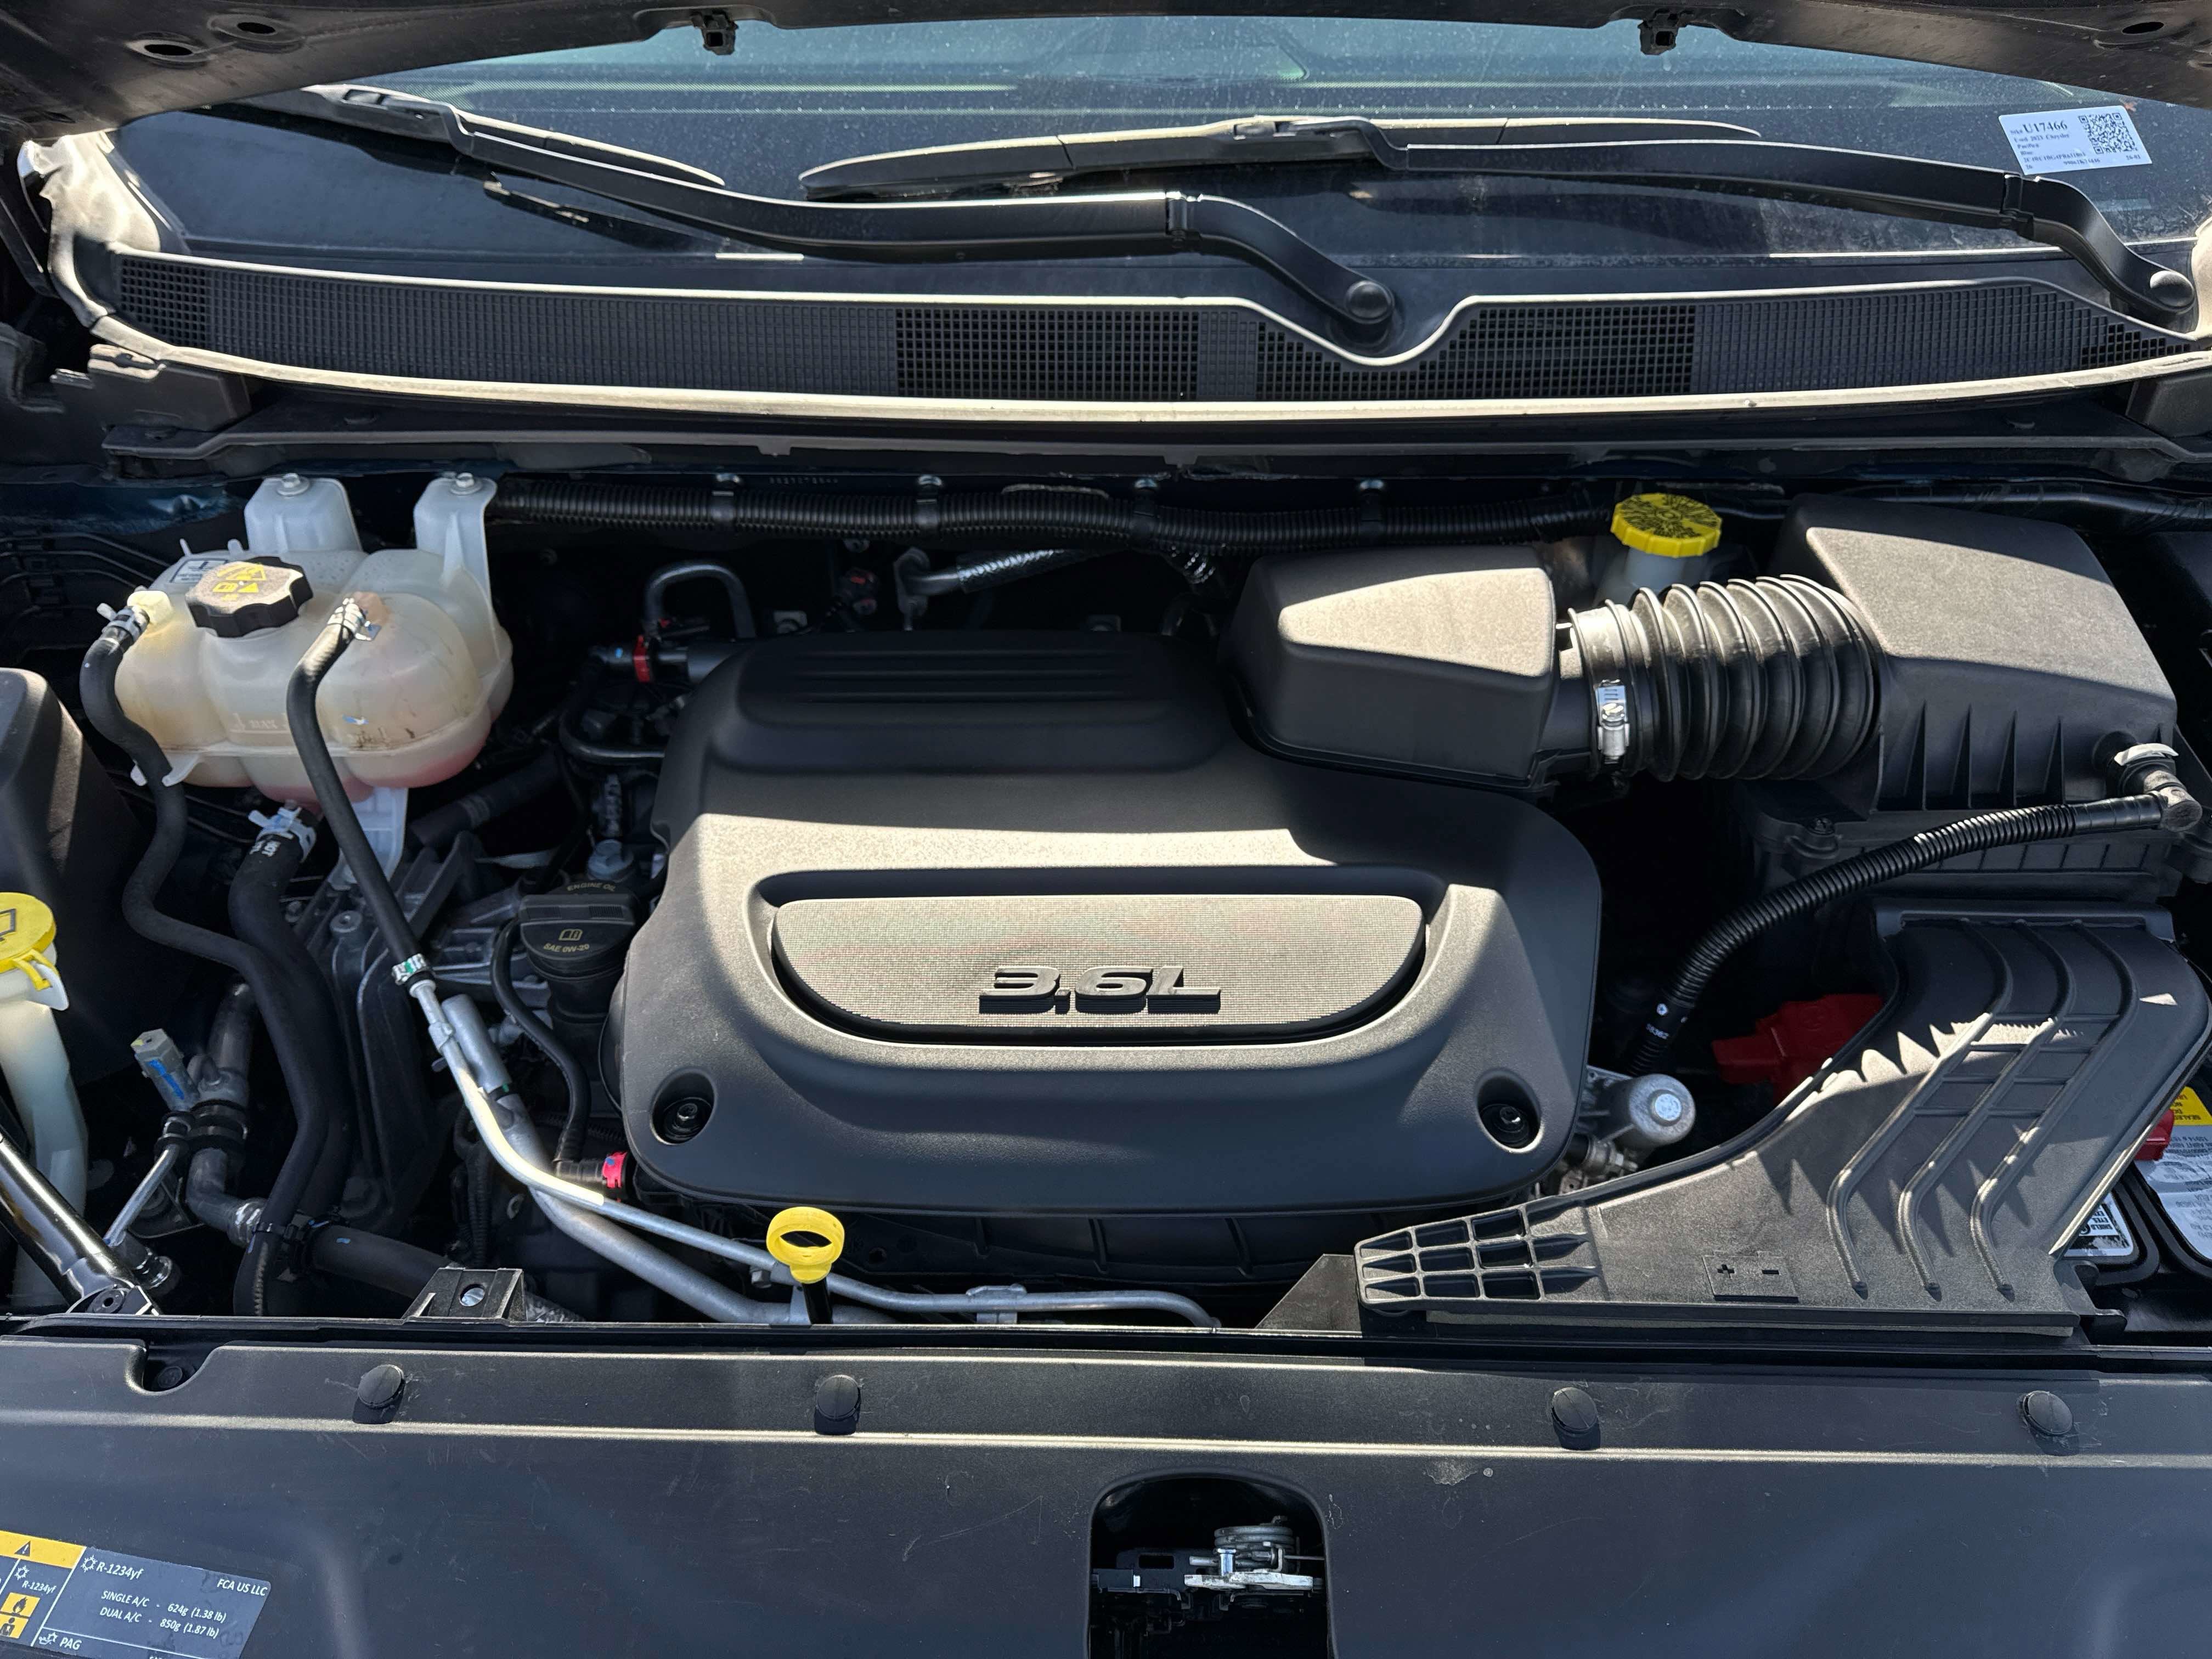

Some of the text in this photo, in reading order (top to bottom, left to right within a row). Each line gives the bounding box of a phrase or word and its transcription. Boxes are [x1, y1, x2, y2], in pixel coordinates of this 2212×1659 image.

[2023, 120, 2068, 133] U17466
[566, 882, 616, 891] ENGINE OIL
[544, 942, 590, 953] SAE 0W-20
[979, 966, 1221, 1013] 3.6L
[96, 1561, 144, 1580] R-1234yf
[22, 1581, 57, 1594] R-1234yf
[217, 1579, 268, 1596] FCA US LLC
[101, 1590, 132, 1604] SINGLE
[132, 1594, 150, 1607] A/C
[167, 1603, 189, 1617] 624g
[191, 1607, 213, 1620] (1.38
[215, 1610, 227, 1624] lb)
[99, 1607, 123, 1619] DUAL
[123, 1612, 142, 1623] A/C
[160, 1618, 181, 1632] 850g
[183, 1622, 206, 1635] (1.87
[206, 1626, 219, 1639] lb)
[60, 1637, 82, 1650] PAG
